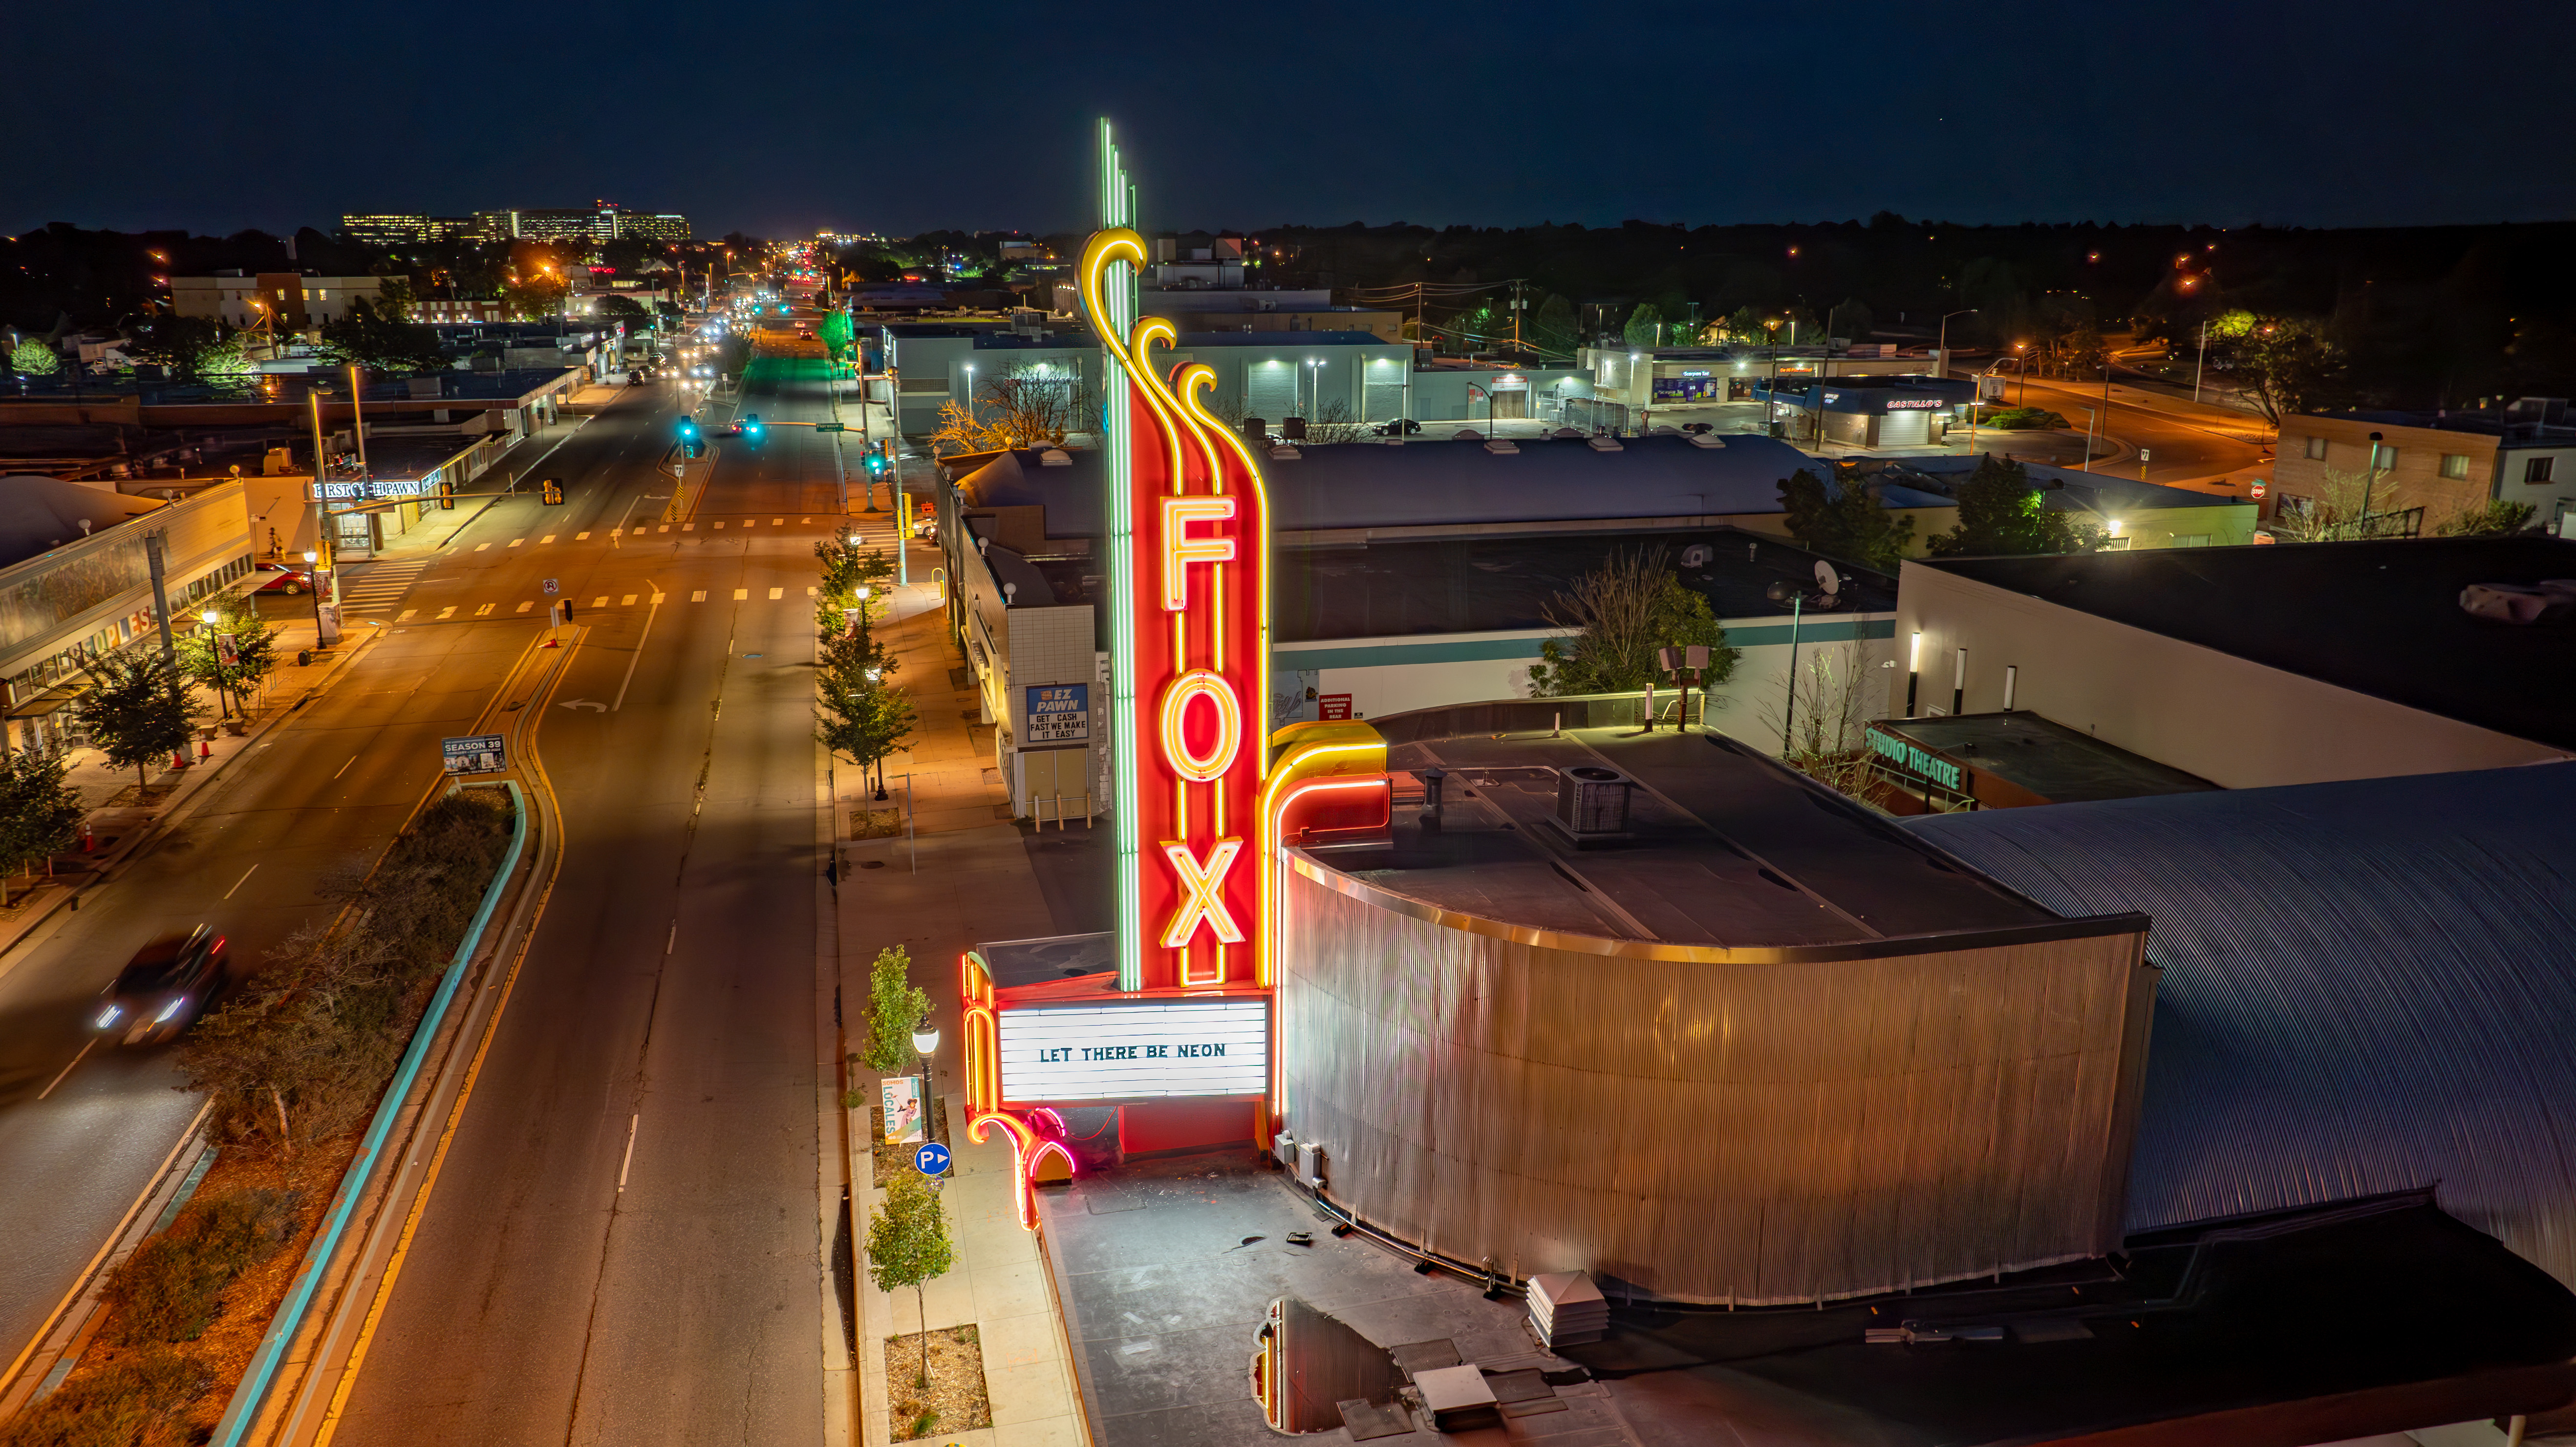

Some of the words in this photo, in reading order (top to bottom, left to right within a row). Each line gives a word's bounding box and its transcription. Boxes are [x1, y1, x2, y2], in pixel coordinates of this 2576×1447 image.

[1887, 400, 1942, 408] CASTILLO'S
[315, 484, 349, 496] FRST
[386, 482, 418, 495] PAWN
[1054, 689, 1072, 700] EZ
[1036, 700, 1078, 712] PAWN
[1057, 713, 1077, 722] CASH
[1159, 495, 1245, 949] FOX
[1030, 723, 1050, 731] FAST
[1064, 721, 1086, 729] MAKE
[1056, 729, 1075, 738] EASY
[445, 742, 486, 752] SEASON
[1865, 727, 1908, 764] STUDIO
[1909, 746, 1960, 790] THEATRE
[1040, 1047, 1073, 1063] LET
[1081, 1046, 1138, 1061] THERE
[1146, 1045, 1168, 1058] BE
[1178, 1043, 1225, 1058] NEON
[883, 1086, 896, 1134] LOCALES
[921, 1151, 934, 1169] P
